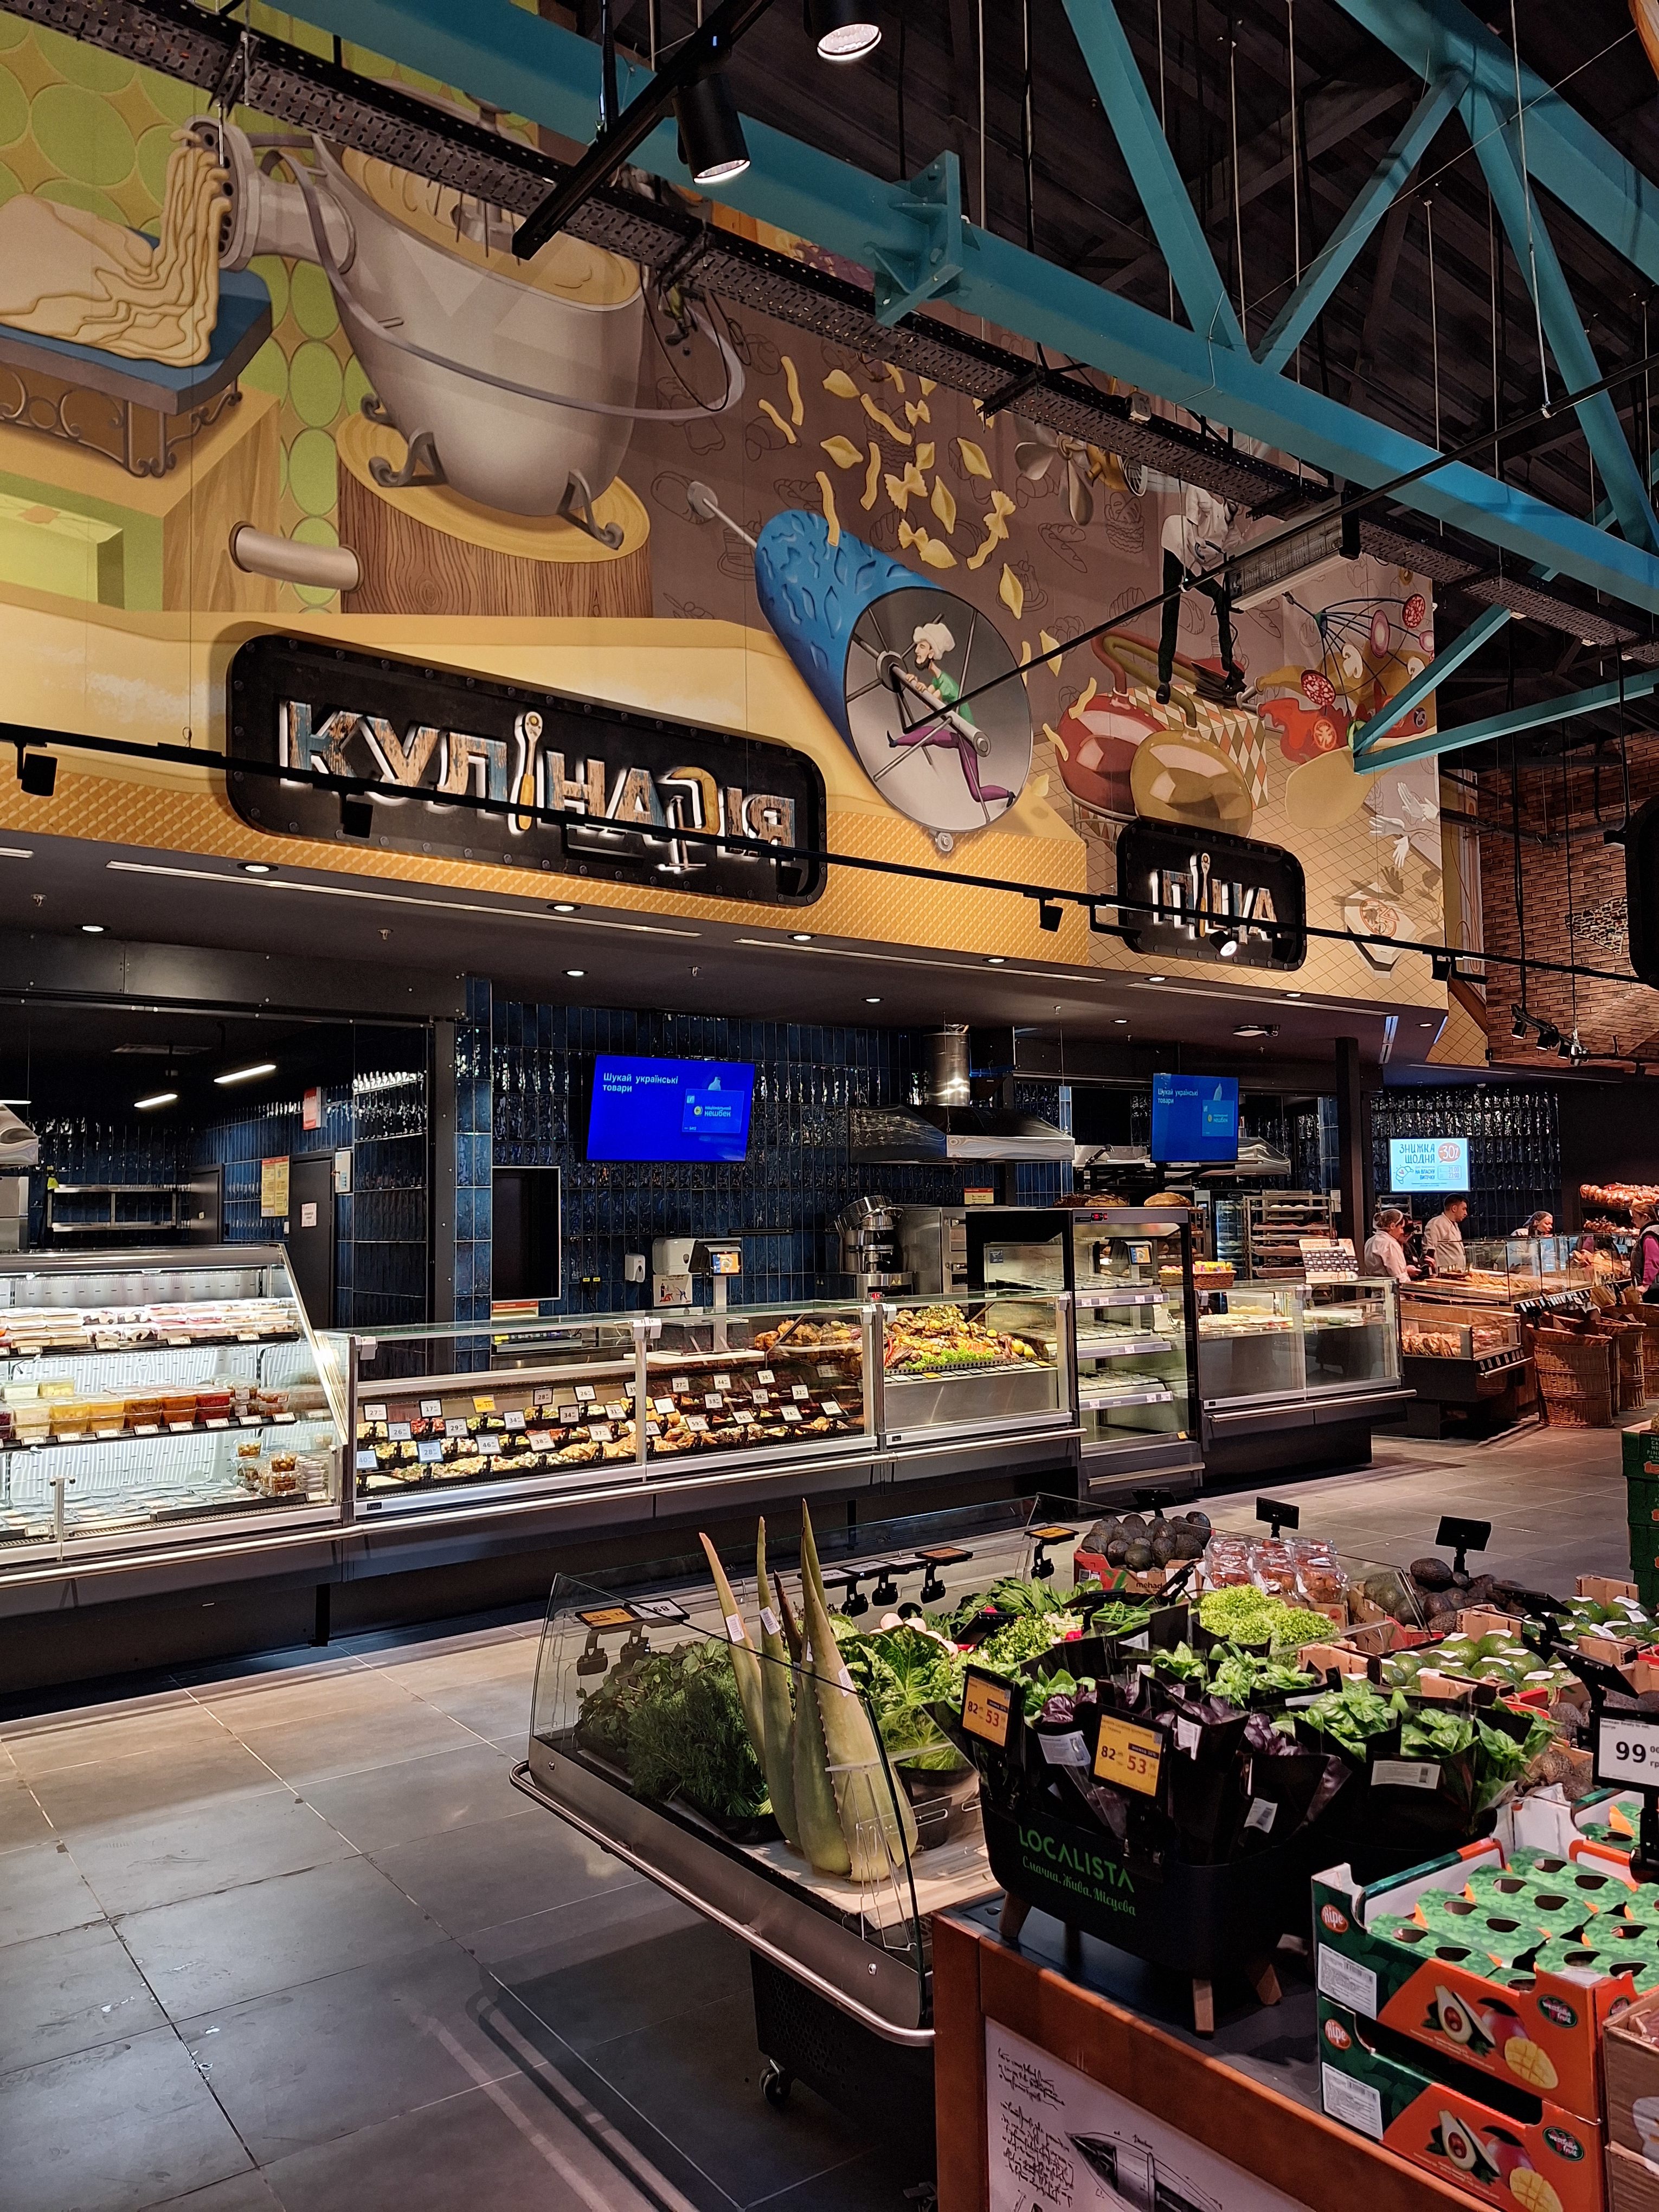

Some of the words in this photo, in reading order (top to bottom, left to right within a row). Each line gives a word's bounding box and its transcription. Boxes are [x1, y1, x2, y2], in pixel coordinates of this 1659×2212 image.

[603, 1072, 632, 1083] Шукай
[635, 1074, 678, 1084] українські
[603, 1084, 632, 1094] товари
[1158, 1088, 1173, 1096] Шукай
[1399, 1143, 1435, 1154] ЗНИЖКА
[1439, 1145, 1458, 1159] -30%
[1405, 1154, 1435, 1164] ЩОДНЯ
[968, 1701, 978, 1714] 82
[986, 1709, 999, 1727] 53
[1101, 1745, 1116, 1760] 82
[1616, 1741, 1647, 1763] 99
[1127, 1755, 1146, 1774] 53
[1018, 1824, 1135, 1893] LOCALISTA
[1322, 1906, 1343, 1928] Ripe
[1326, 2021, 1346, 2044] Ripe
